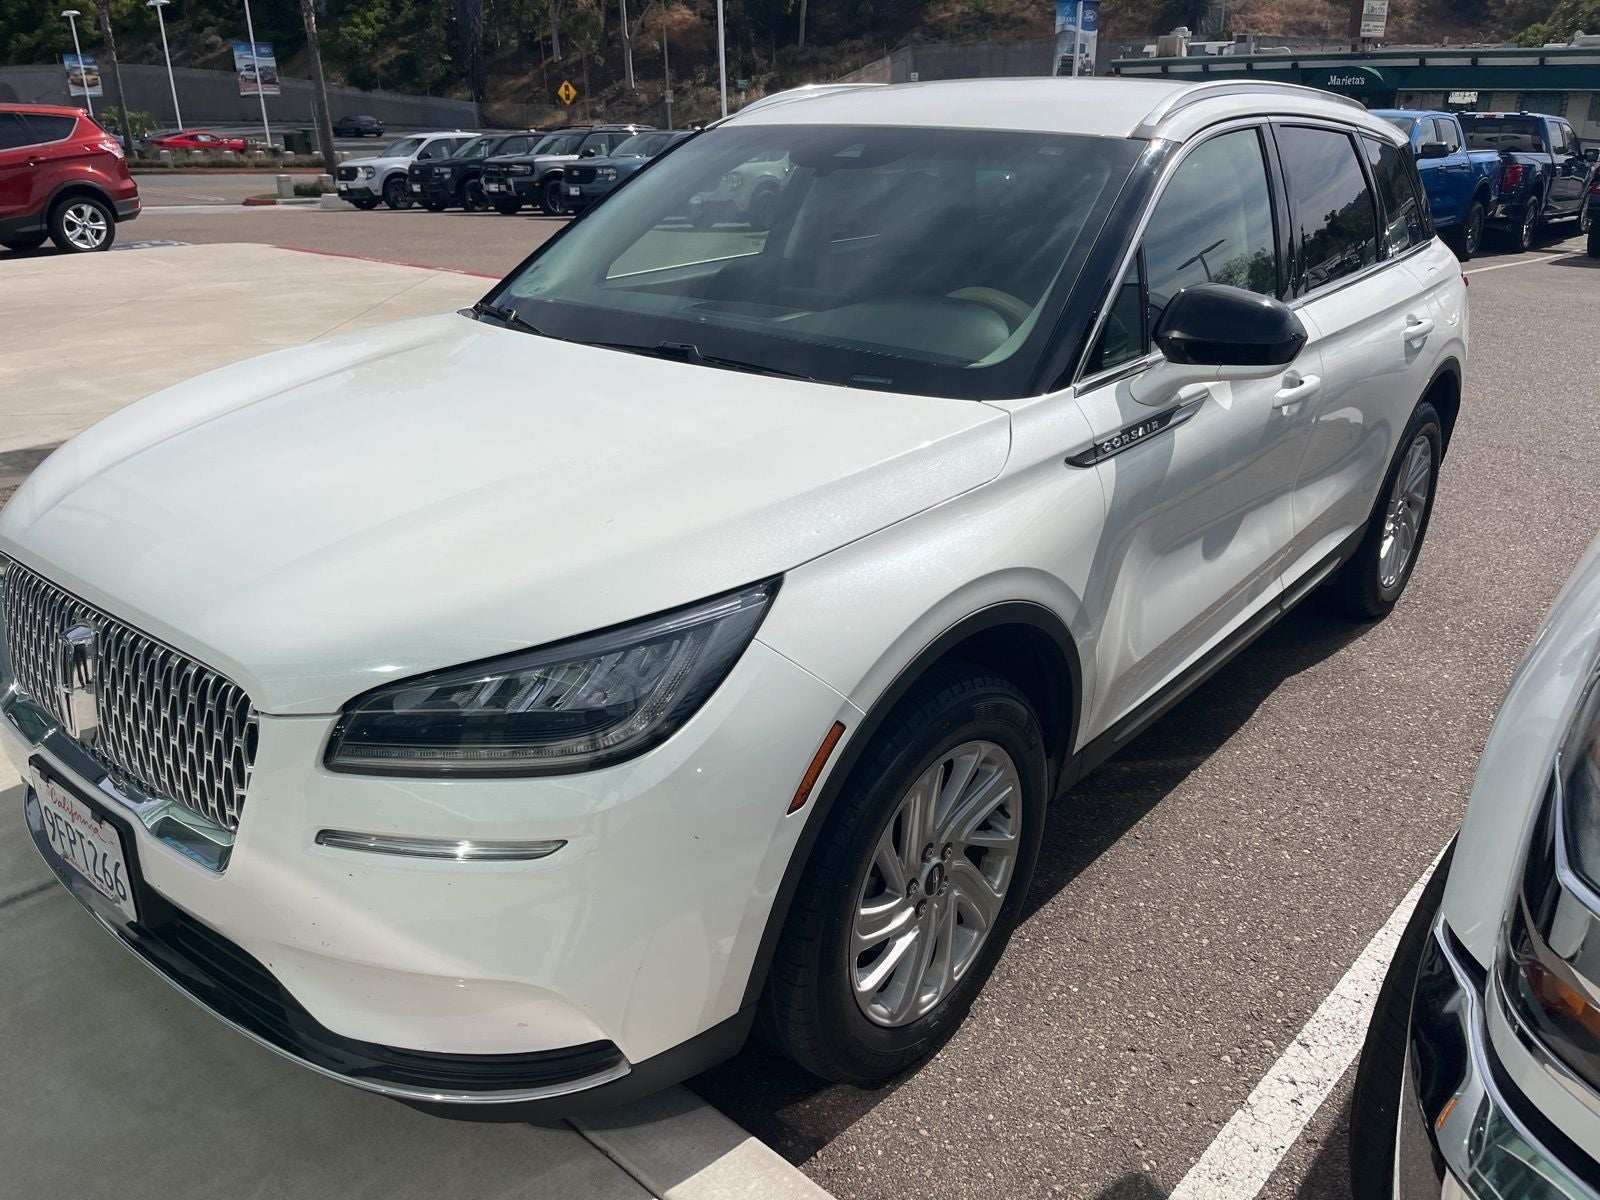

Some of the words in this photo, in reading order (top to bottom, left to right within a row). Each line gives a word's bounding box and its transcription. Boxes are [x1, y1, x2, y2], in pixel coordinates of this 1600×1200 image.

[1328, 75, 1365, 85] Marieta's
[1102, 420, 1159, 452] CORSAIR
[48, 786, 102, 839] California
[44, 805, 127, 901] 9FPT266
